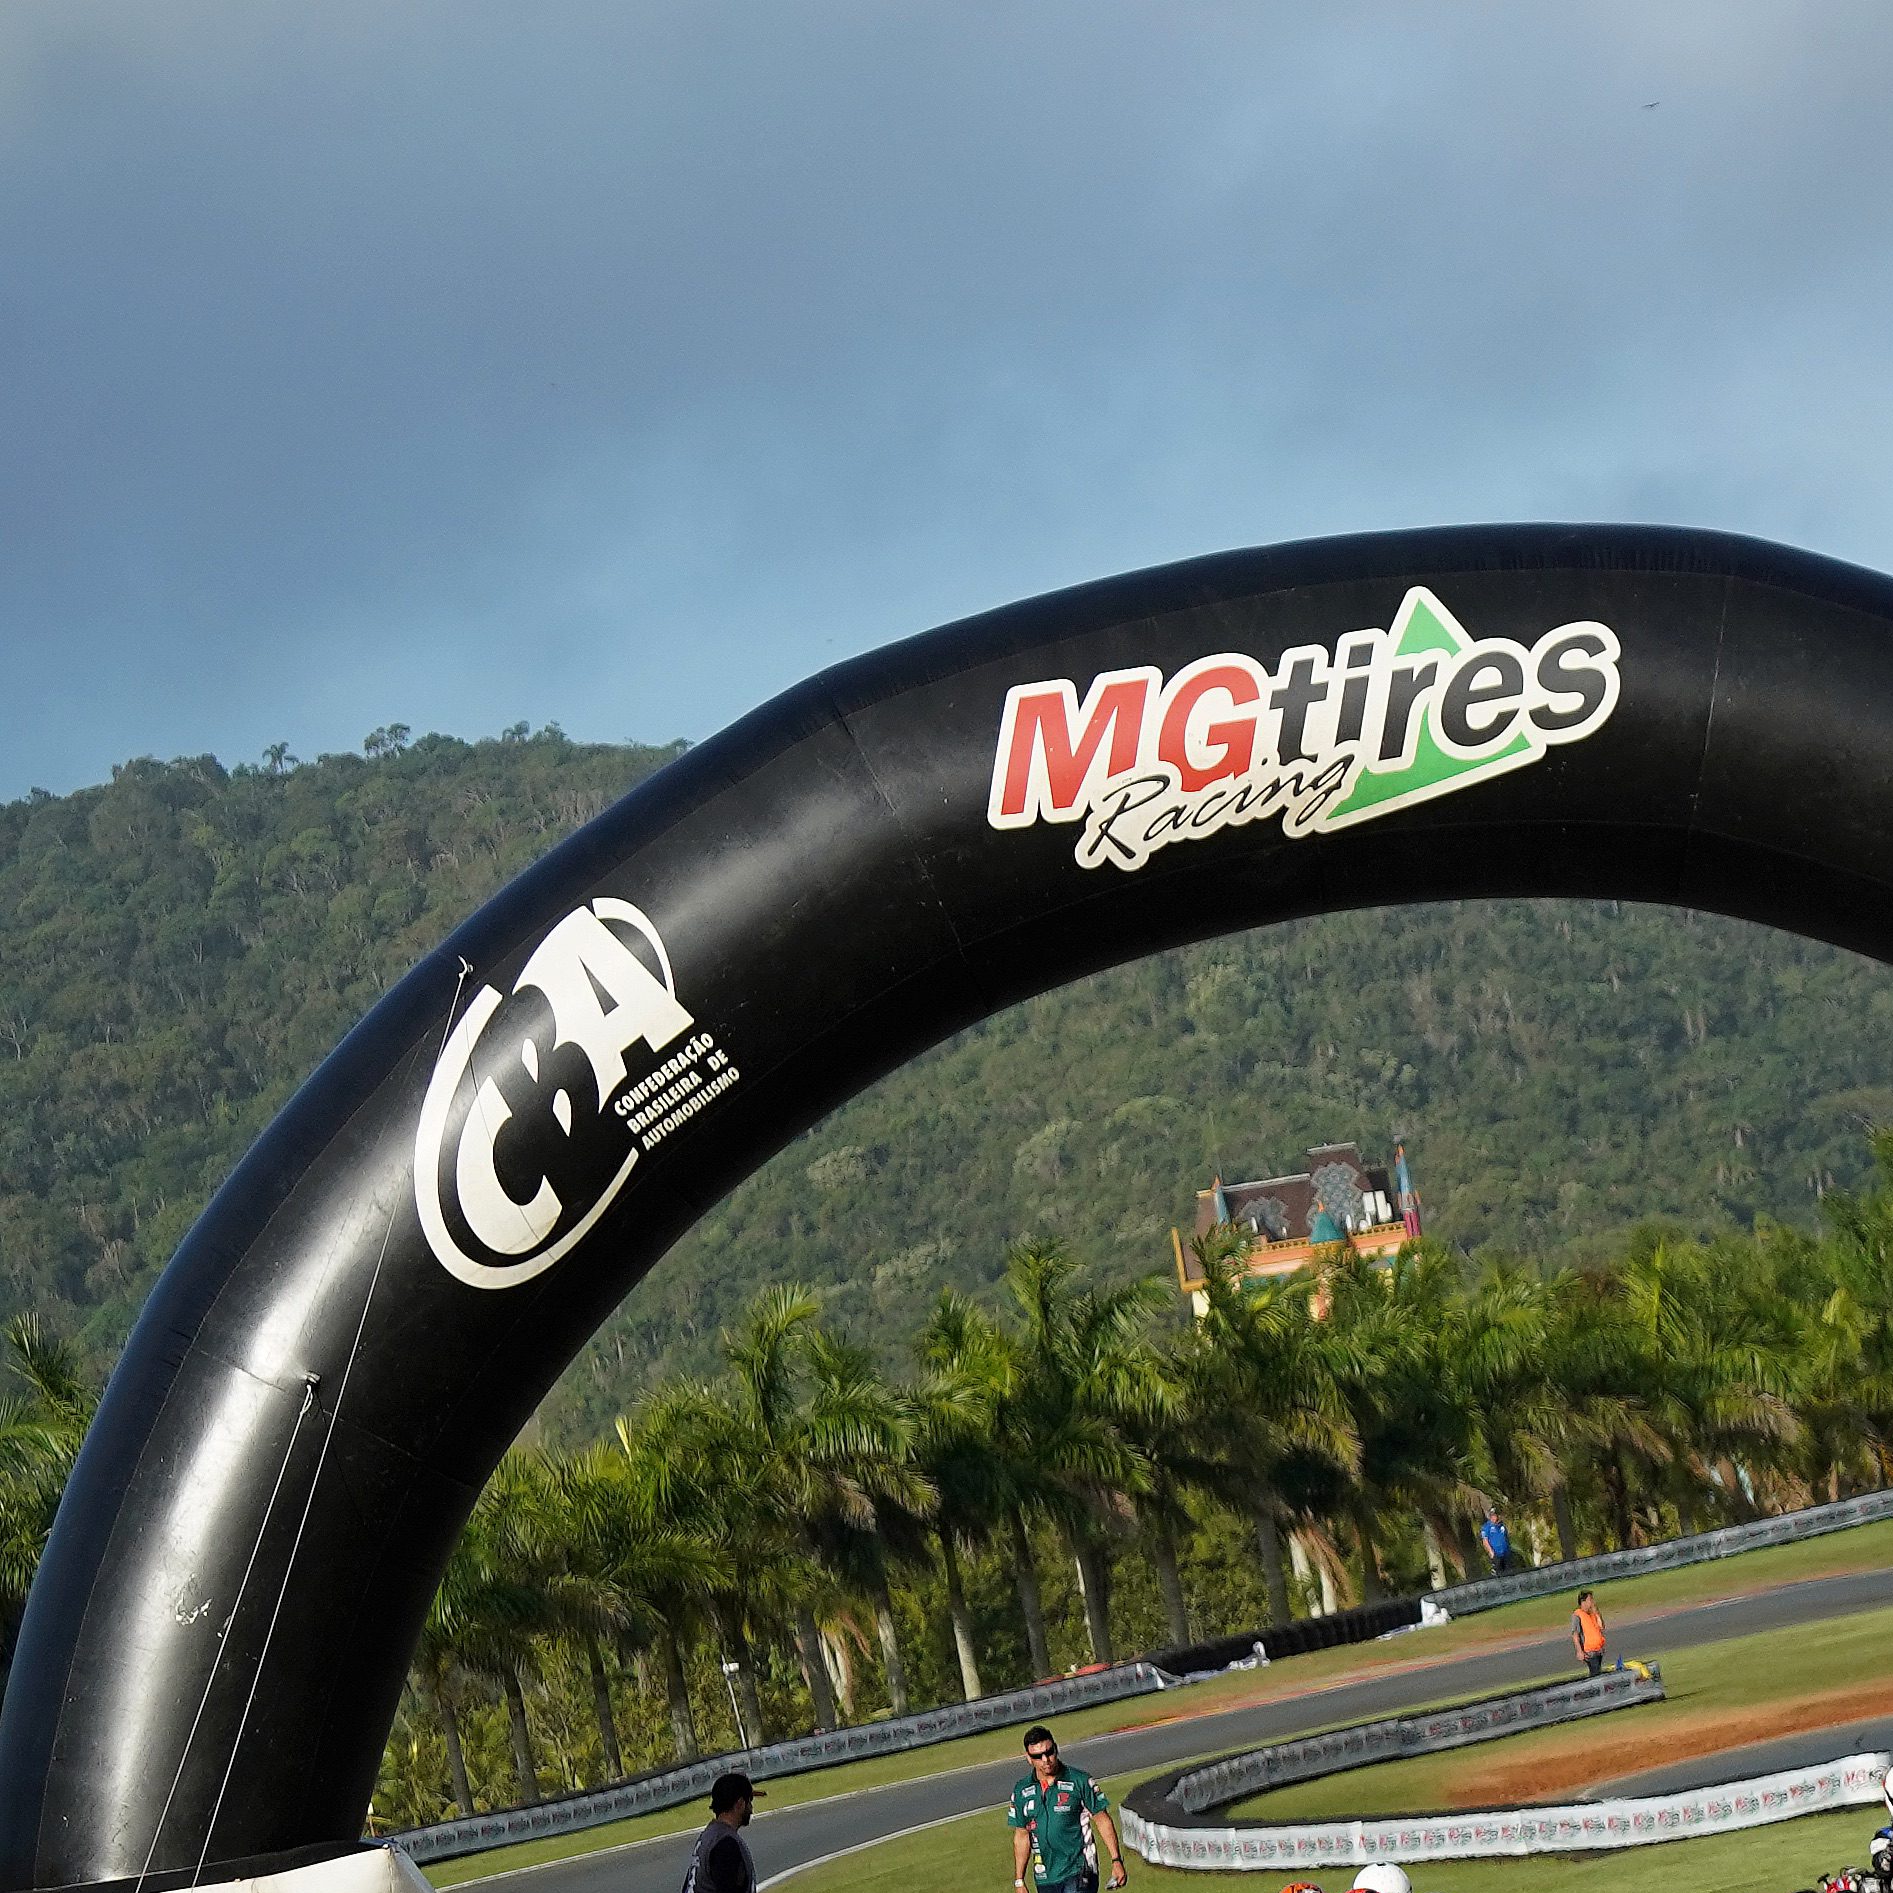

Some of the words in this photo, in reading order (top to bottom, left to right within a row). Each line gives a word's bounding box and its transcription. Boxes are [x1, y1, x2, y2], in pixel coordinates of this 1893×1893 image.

[1000, 634, 1608, 815] MGtires
[1087, 752, 1356, 860] Racing
[614, 1032, 714, 1118] CONFEDERAÇÃO
[626, 1072, 703, 1135] BRASILEIRA
[706, 1049, 729, 1072] DE
[641, 1066, 740, 1151] AUTOMOBILISMO
